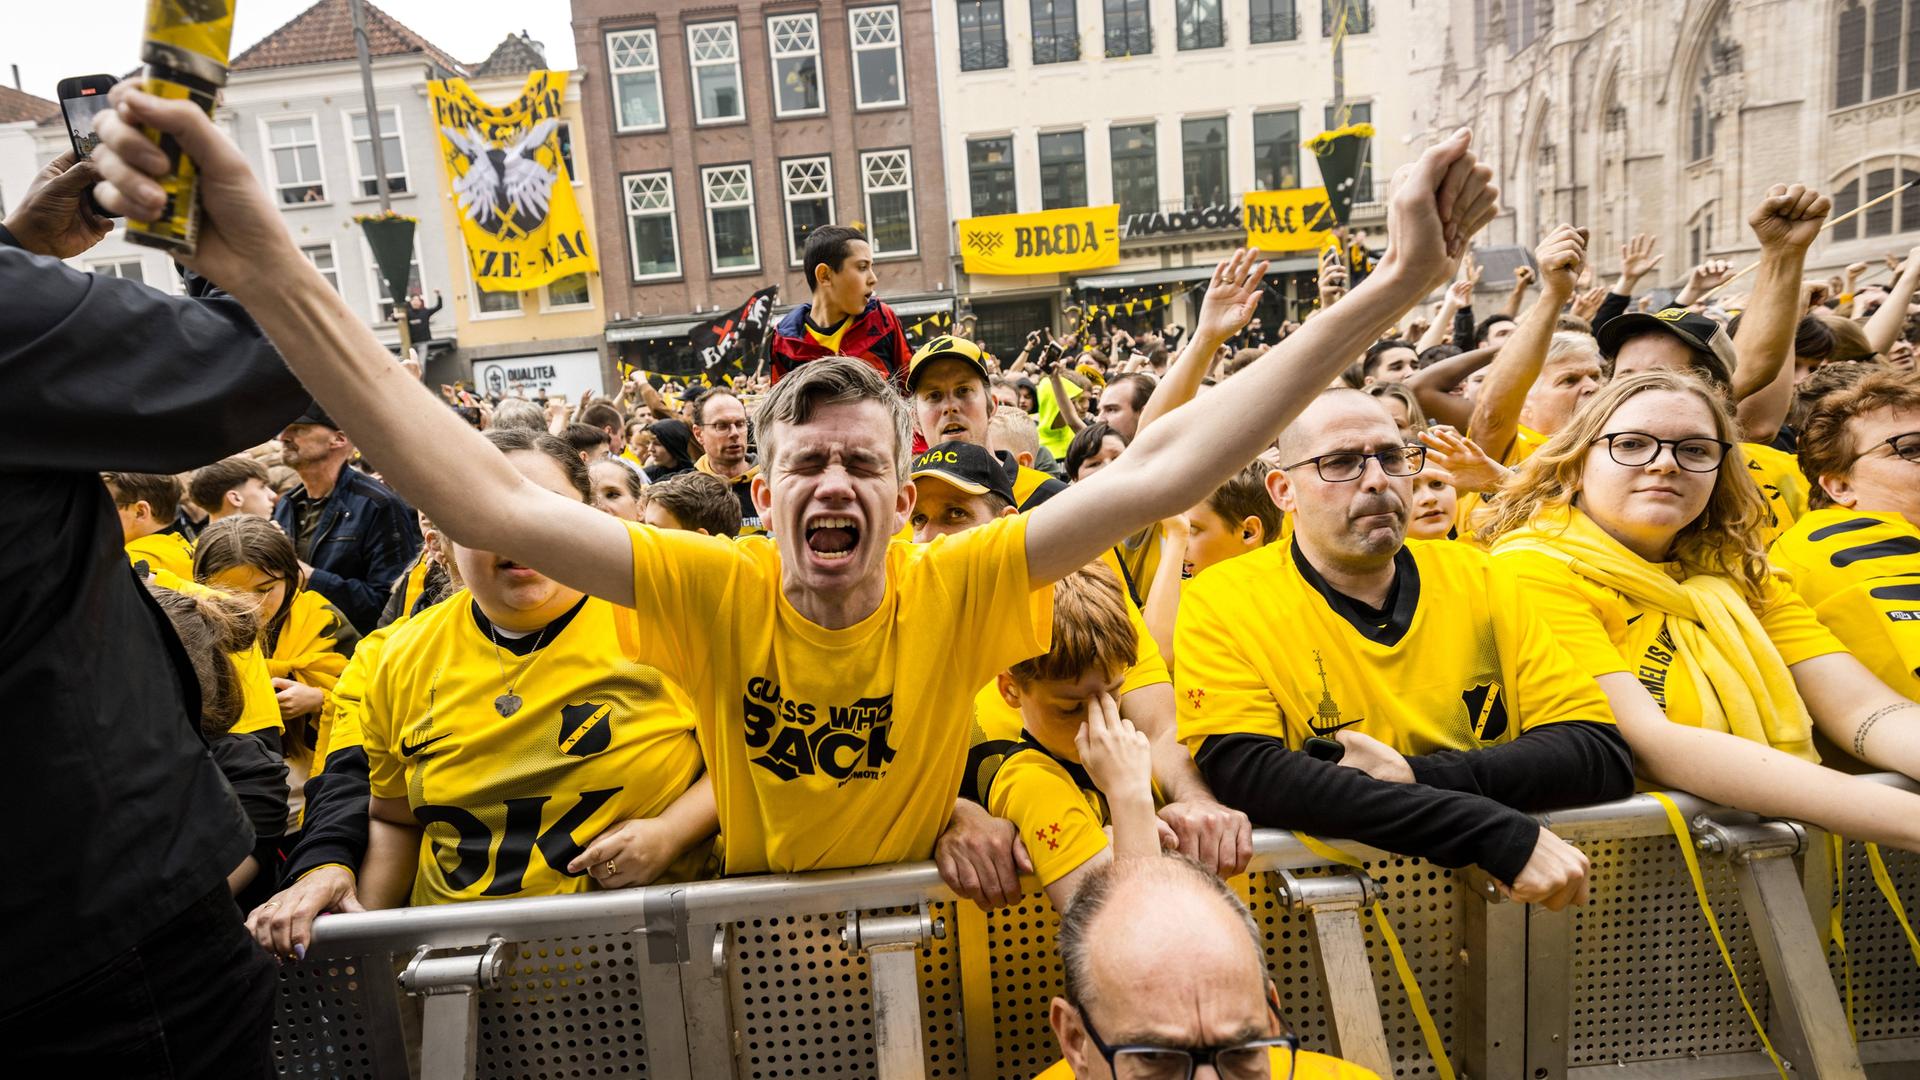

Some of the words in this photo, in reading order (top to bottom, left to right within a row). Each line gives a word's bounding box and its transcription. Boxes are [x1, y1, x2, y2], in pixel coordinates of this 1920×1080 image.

[1246, 204, 1298, 234] NAC
[1014, 221, 1099, 258] BREDA
[917, 450, 958, 467] NAC
[1644, 645, 1673, 668] IS
[743, 694, 897, 780] BACK
